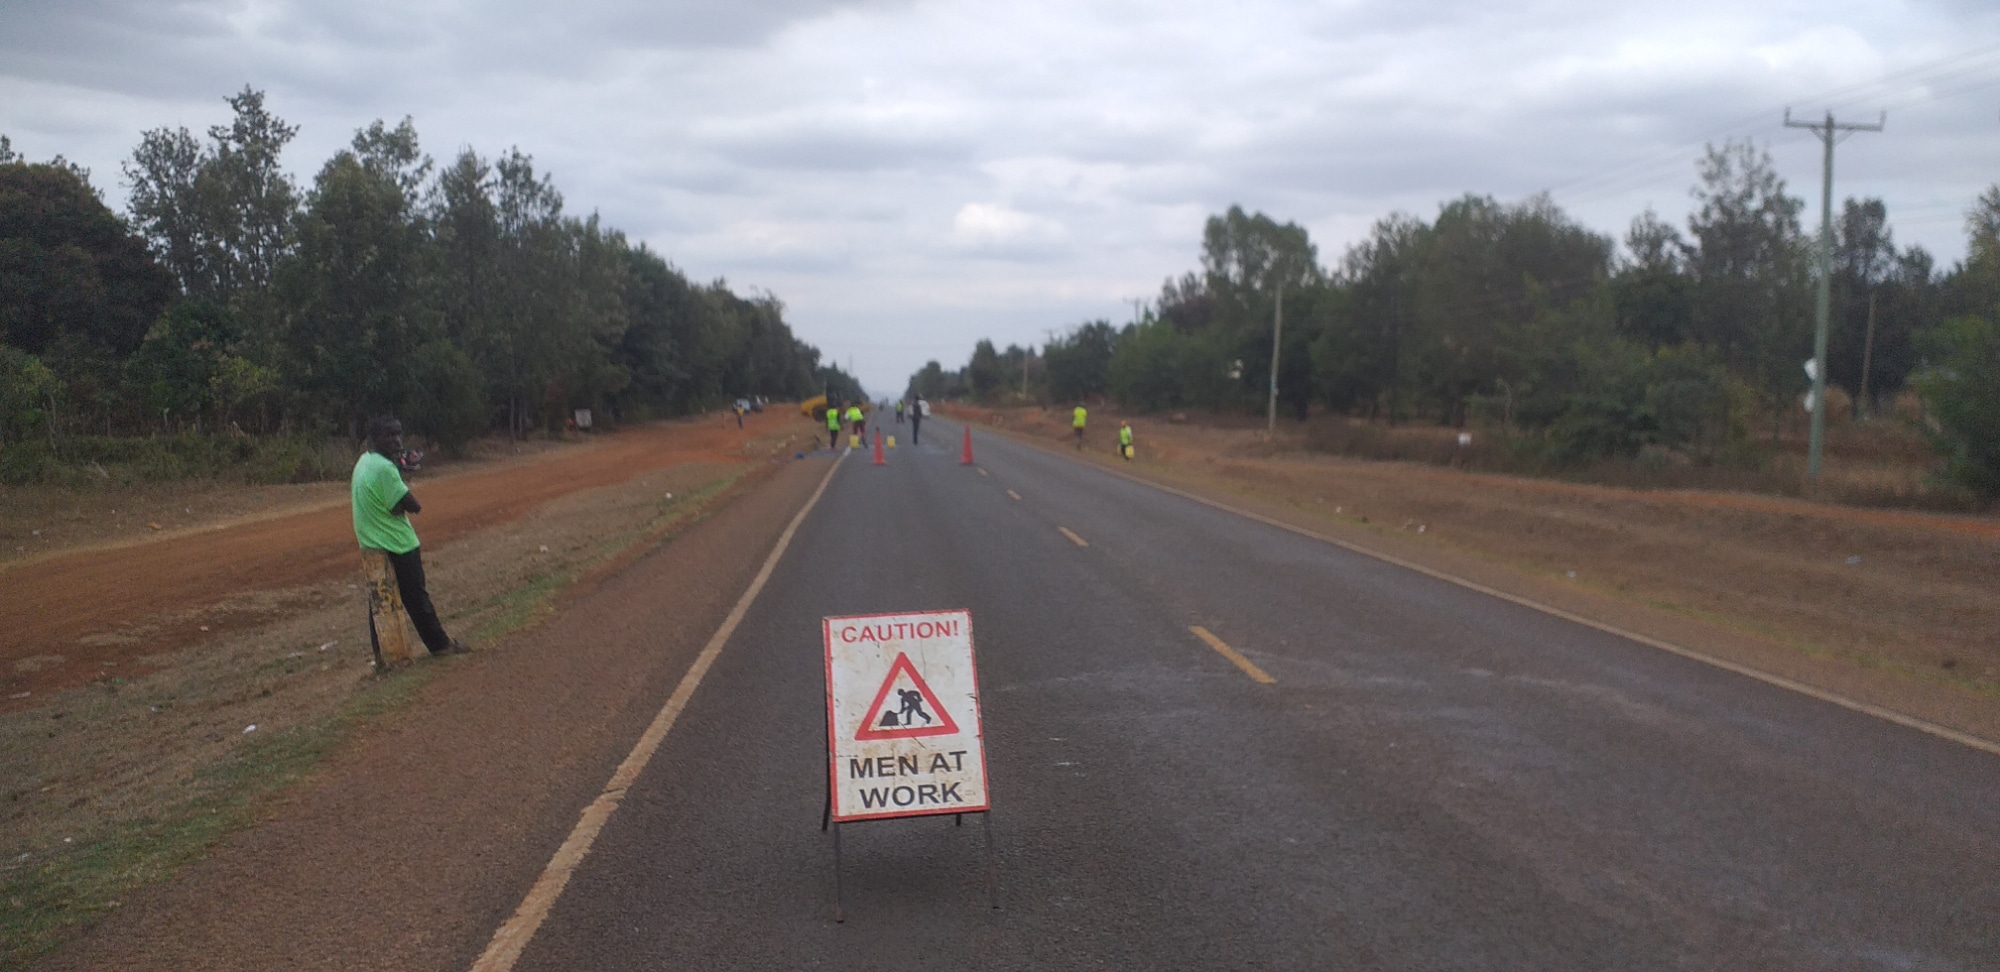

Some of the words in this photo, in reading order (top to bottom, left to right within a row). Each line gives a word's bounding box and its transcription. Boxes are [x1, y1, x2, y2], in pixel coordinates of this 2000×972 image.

[841, 620, 959, 643] CAUTION!
[850, 755, 919, 779] MEN
[929, 750, 968, 773] AT
[859, 782, 963, 809] WORK
